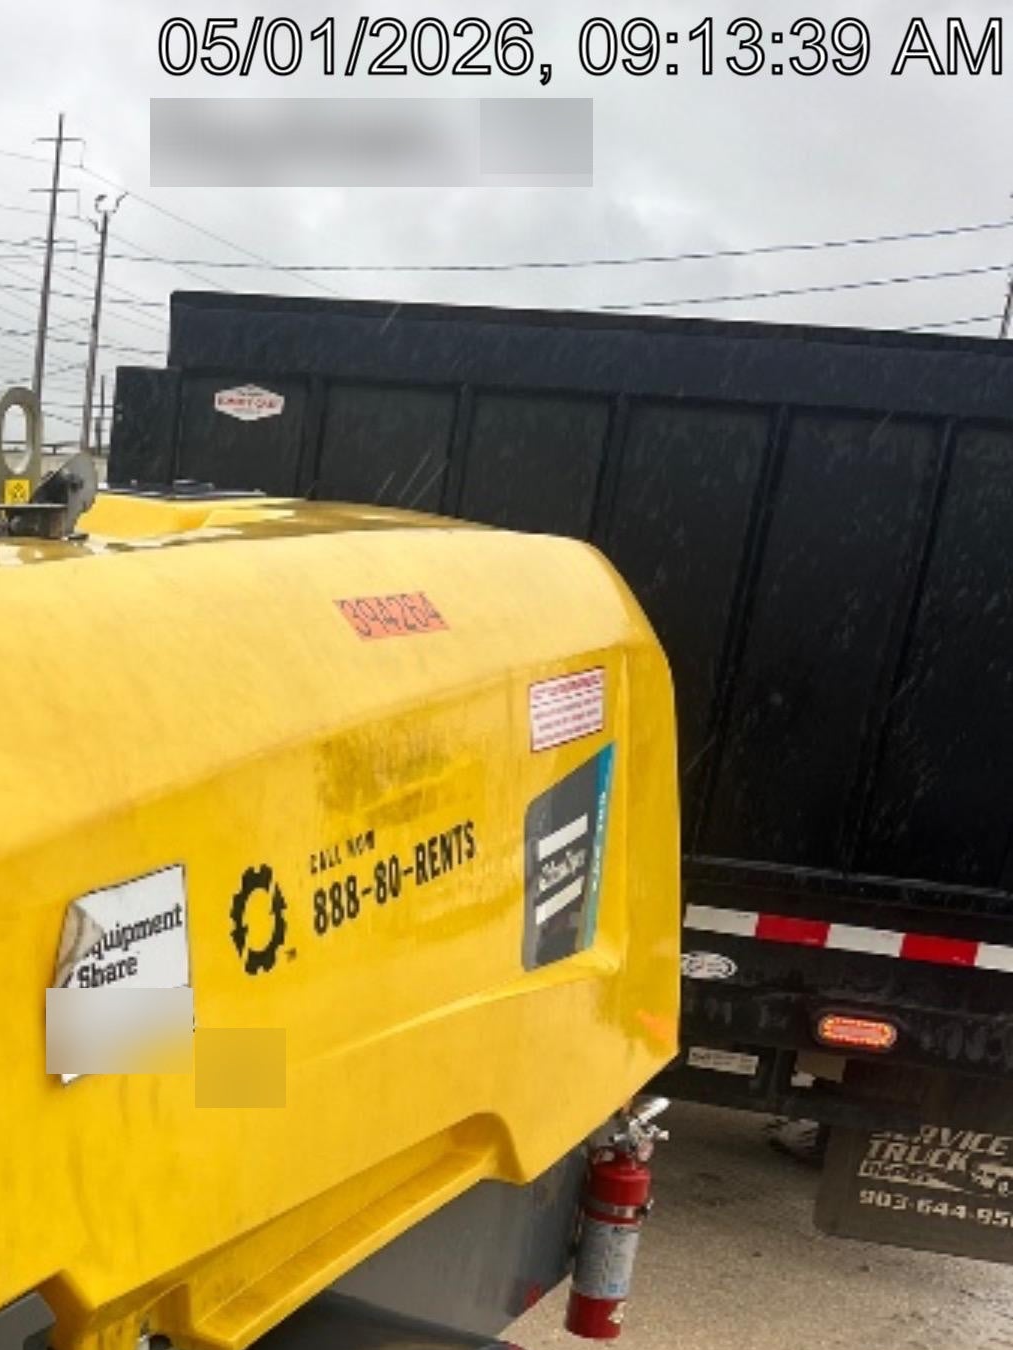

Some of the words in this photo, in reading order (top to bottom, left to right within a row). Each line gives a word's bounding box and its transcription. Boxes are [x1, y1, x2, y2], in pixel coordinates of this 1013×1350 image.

[310, 845, 342, 876] CALL
[313, 819, 477, 937] 888-80-RENTS
[85, 902, 184, 961] quipment
[77, 956, 139, 989] Share
[866, 1139, 972, 1172] TRUCK
